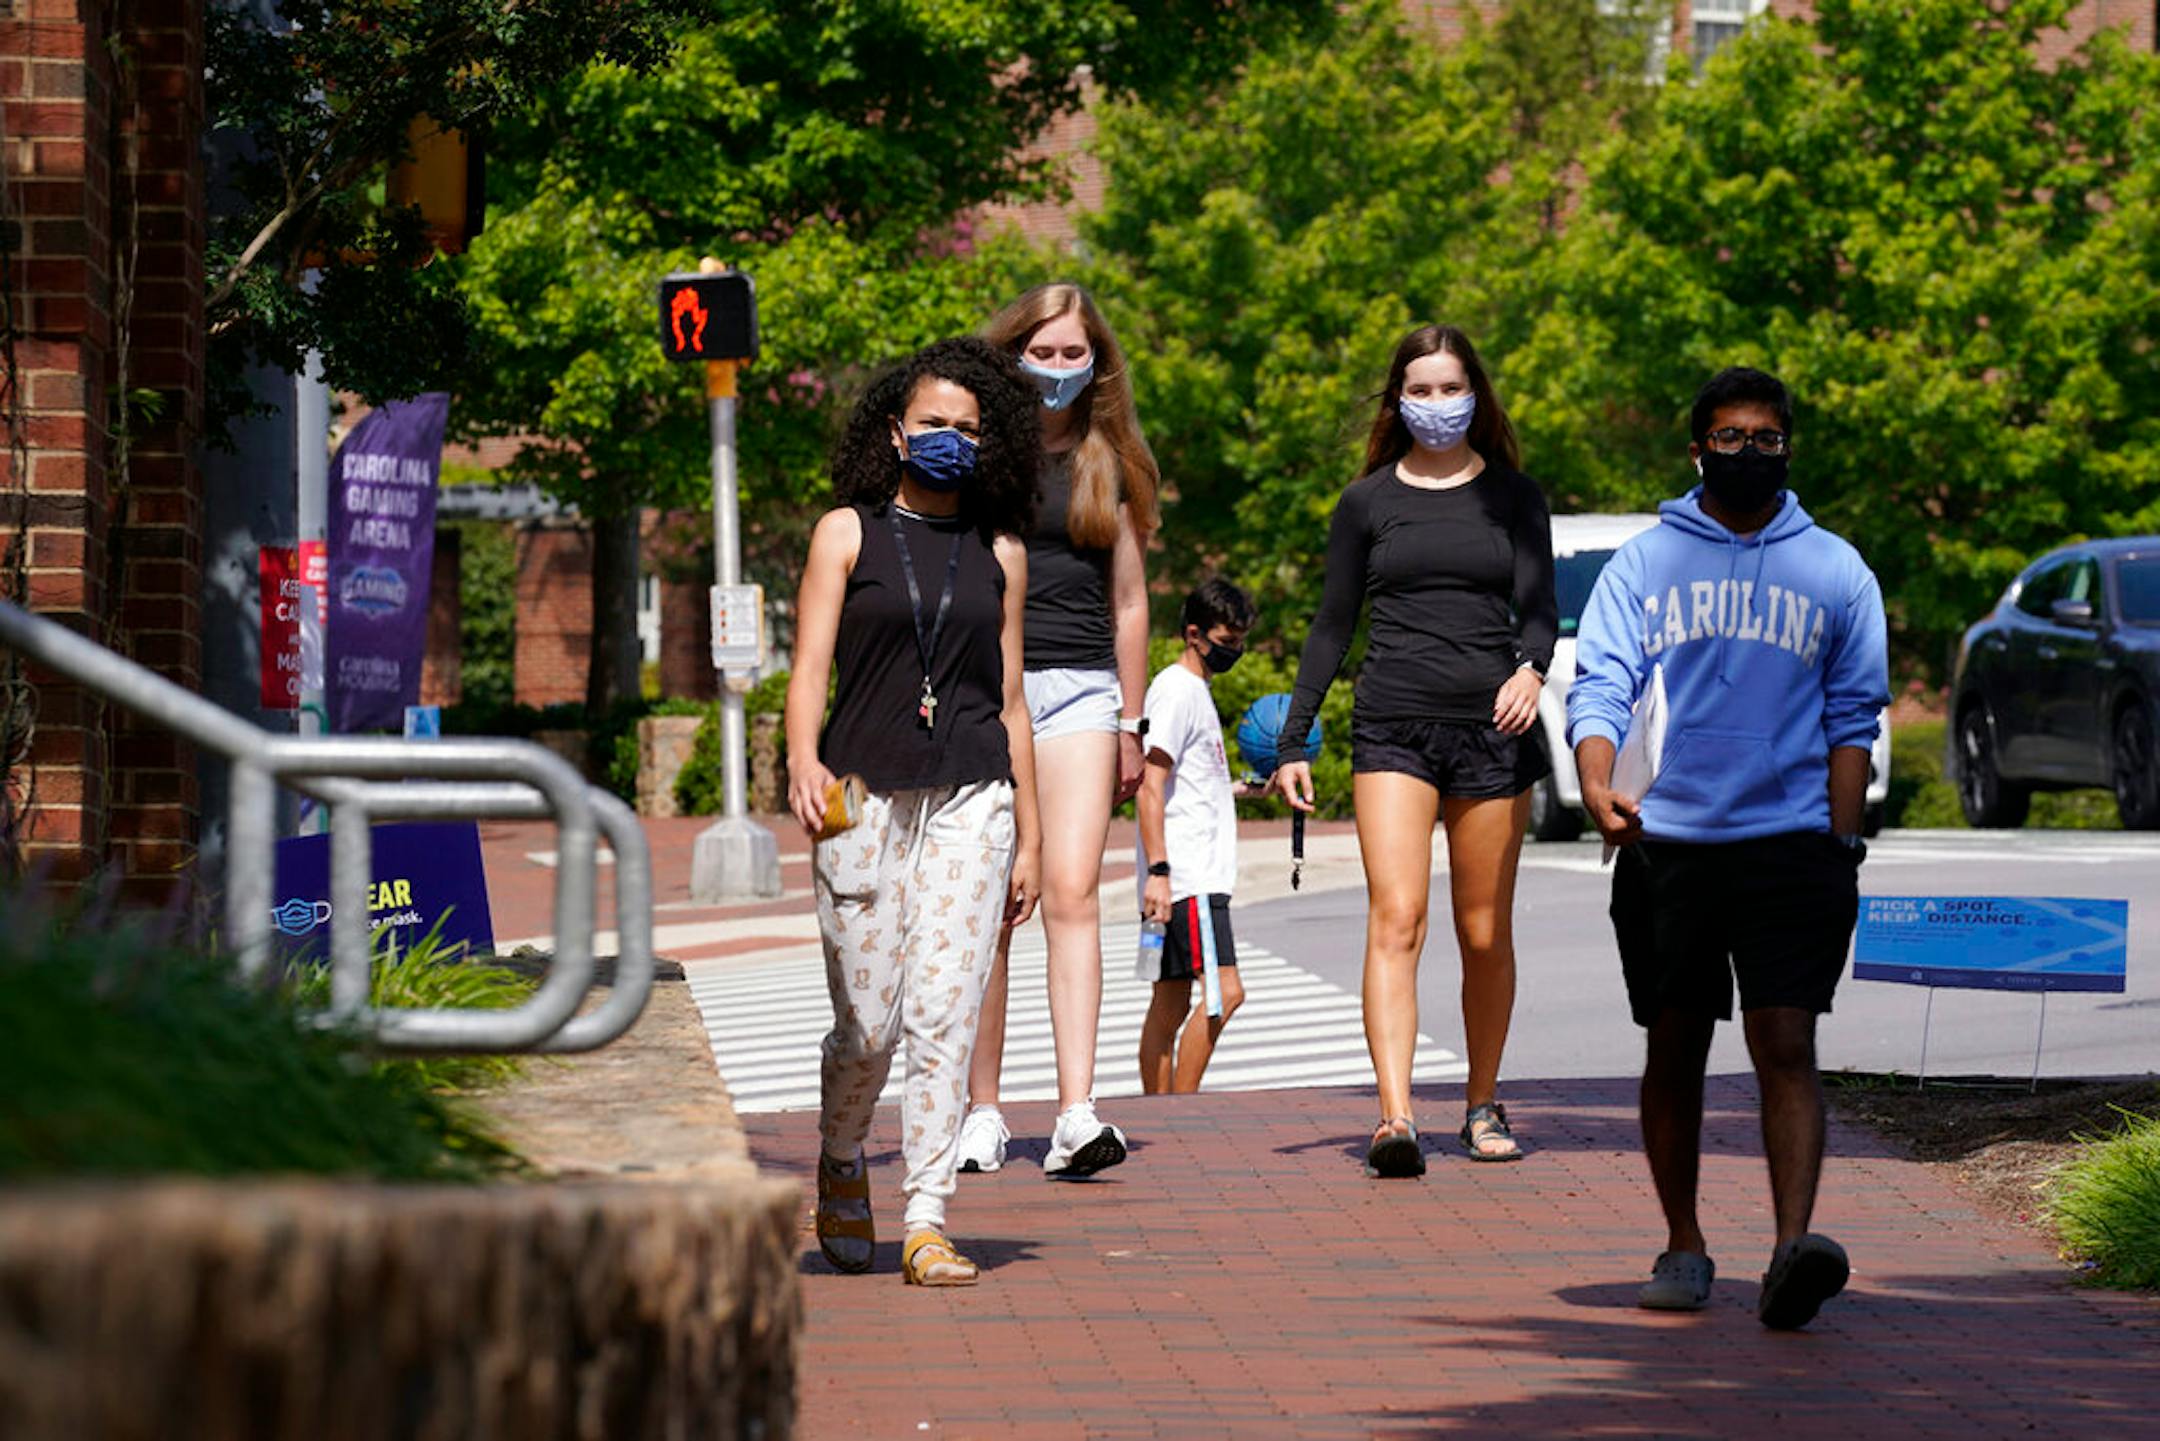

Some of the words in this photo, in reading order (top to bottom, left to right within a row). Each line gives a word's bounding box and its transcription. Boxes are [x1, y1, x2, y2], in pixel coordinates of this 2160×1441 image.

[342, 453, 430, 487] CAROLINA
[347, 485, 419, 518] GAMING
[350, 519, 411, 550] ARENA
[1644, 579, 1825, 669] CAROLINA
[367, 879, 413, 911] EAR
[1869, 900, 1916, 911] PICK
[1923, 900, 1937, 912] A
[1944, 901, 2000, 912] SPOT.
[1867, 911, 1921, 923] KEEP
[1927, 913, 2032, 926] DISTANCE.
